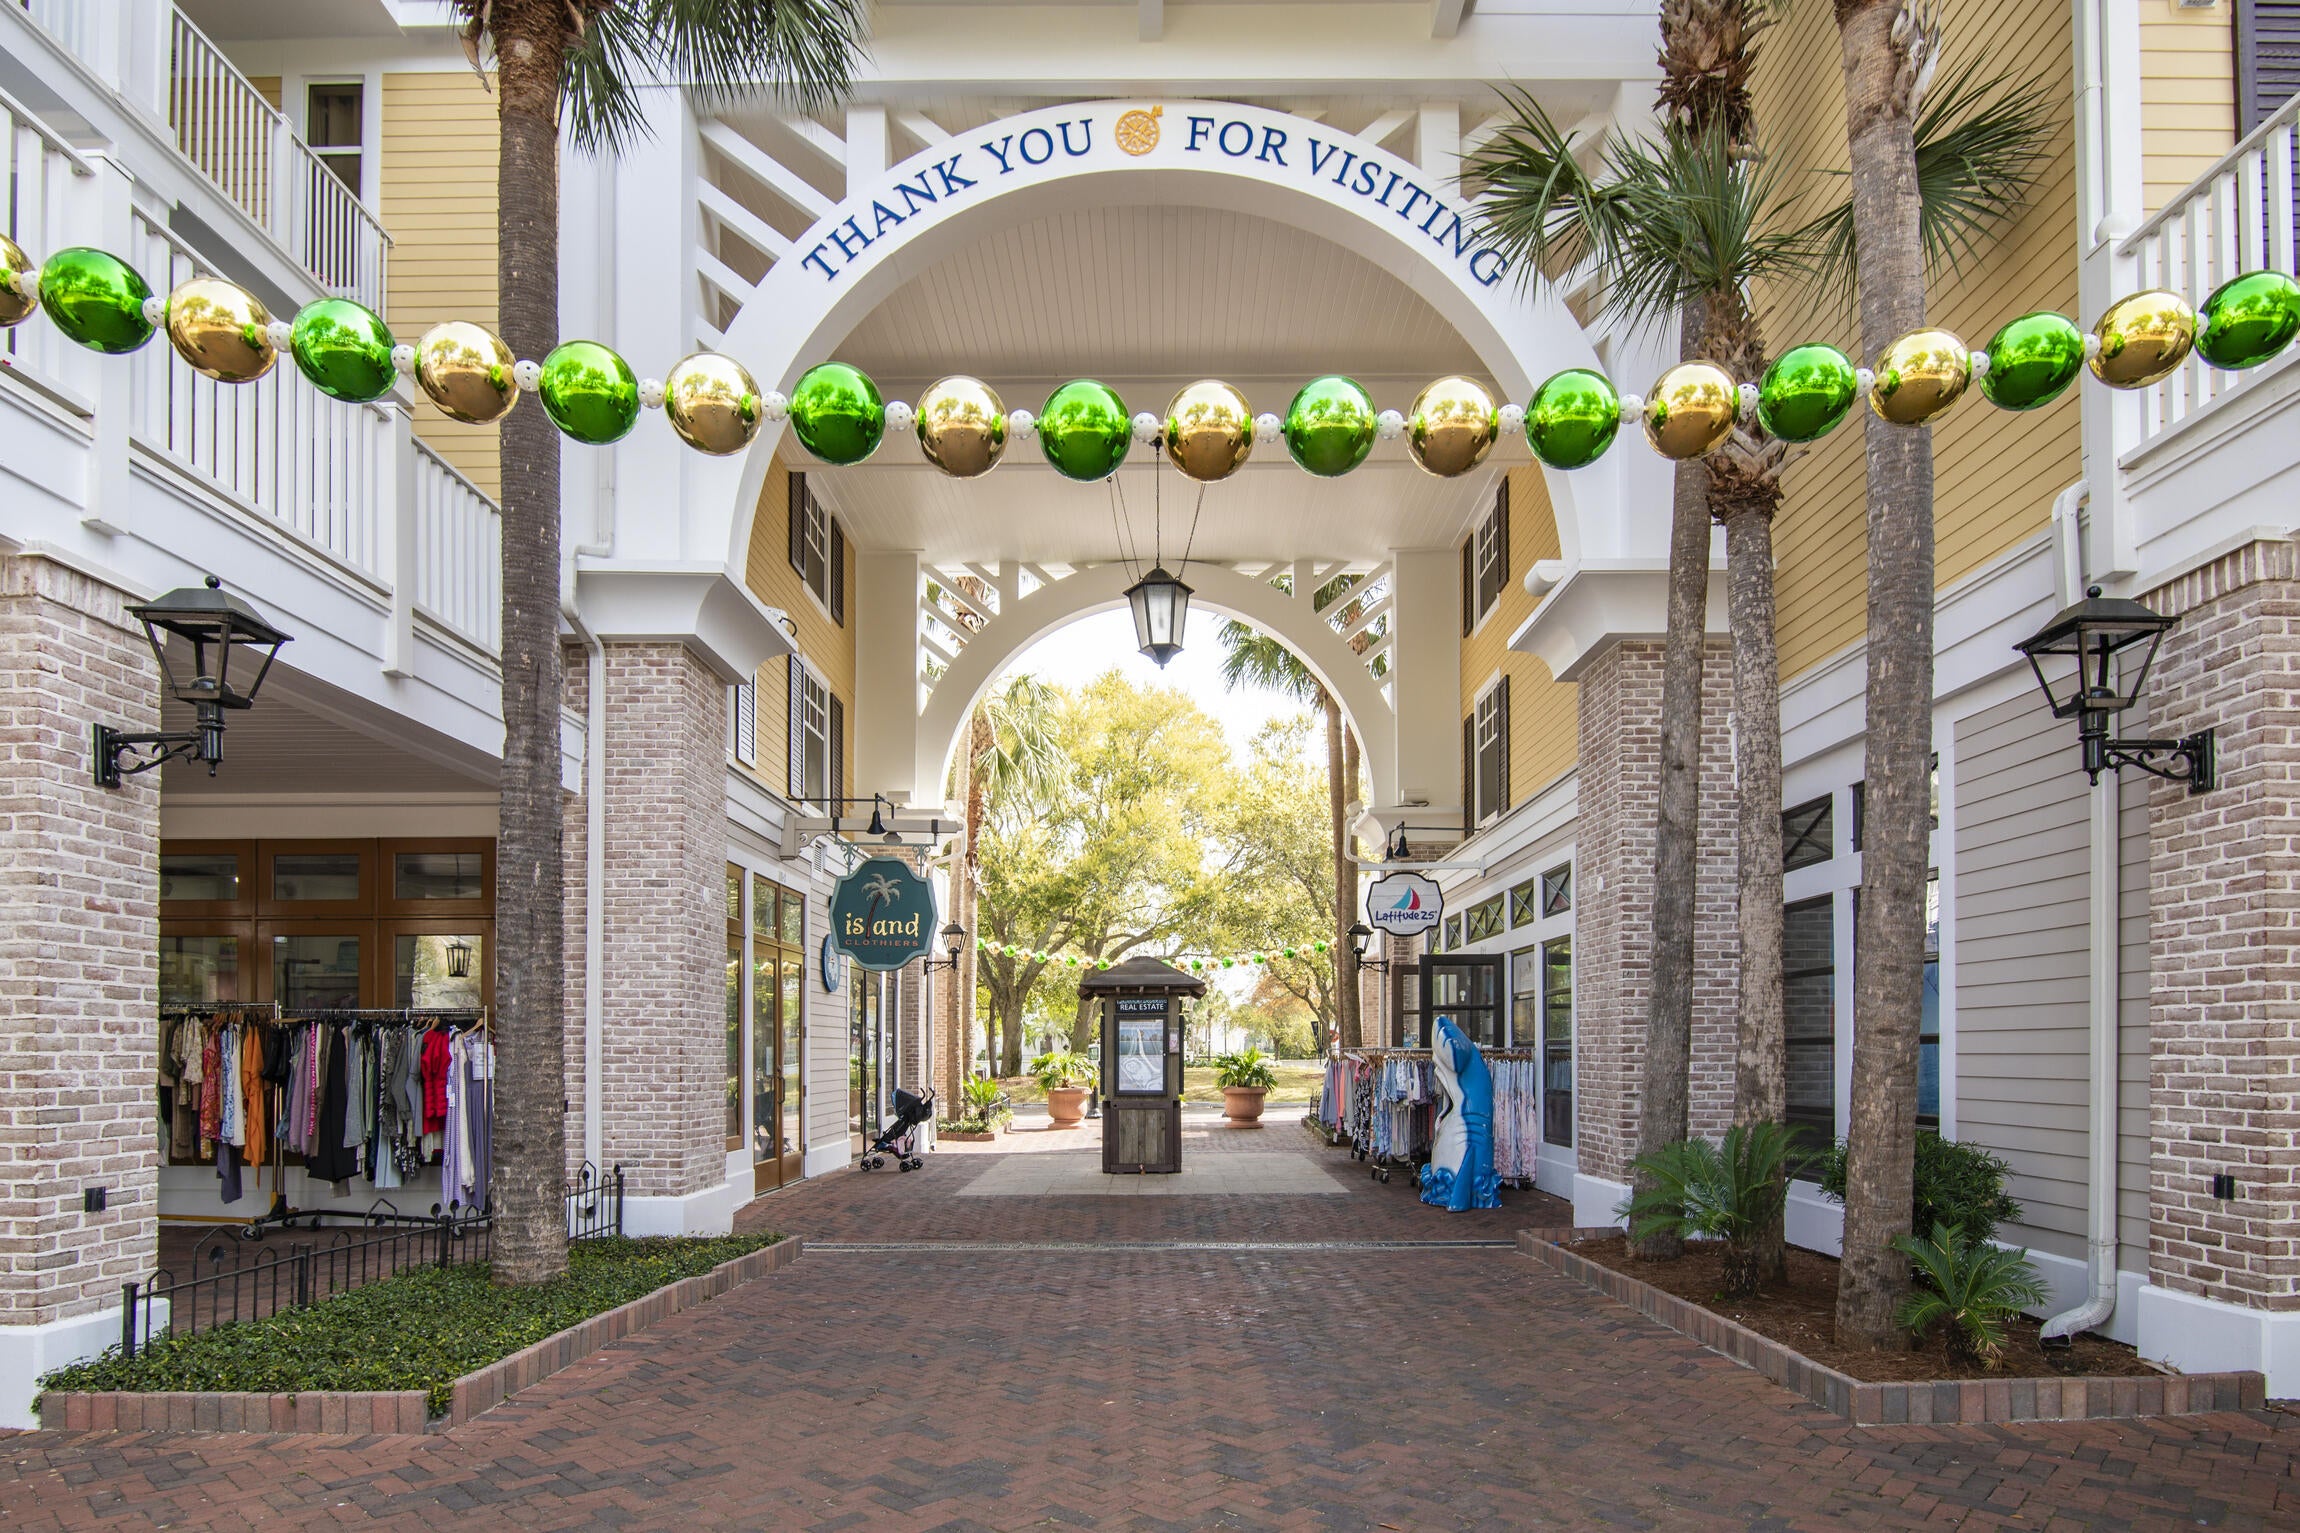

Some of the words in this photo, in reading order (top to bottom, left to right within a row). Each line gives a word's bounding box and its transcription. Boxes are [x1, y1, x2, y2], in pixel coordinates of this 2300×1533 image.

[801, 153, 978, 281] THANK
[980, 118, 1093, 175] YOU
[1184, 115, 1289, 167] FOR
[1307, 137, 1508, 288] VISITING
[1375, 910, 1420, 923] Latitude
[845, 939, 919, 947] CLOTHIERS
[1119, 1003, 1138, 1011] REAL
[1139, 1003, 1164, 1011] ESTATE
